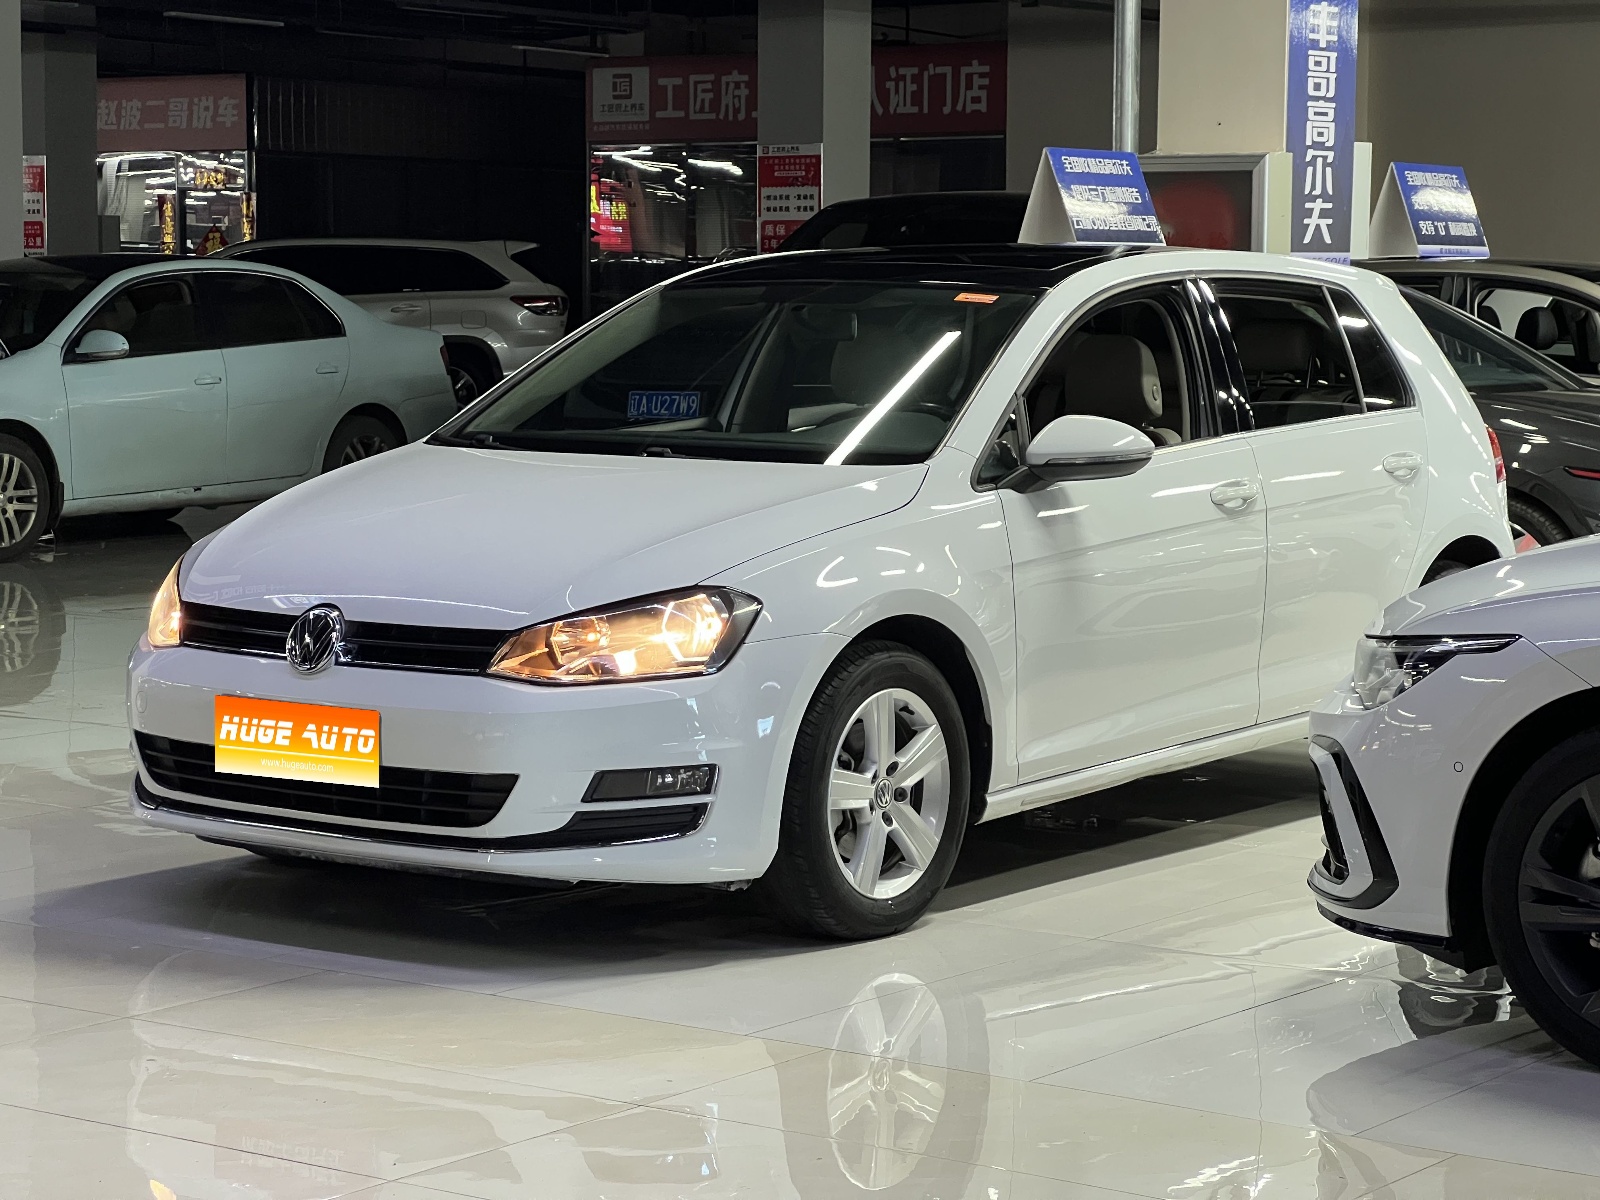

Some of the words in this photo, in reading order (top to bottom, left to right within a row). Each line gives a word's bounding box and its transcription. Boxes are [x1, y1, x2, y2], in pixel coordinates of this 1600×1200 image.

[655, 69, 757, 121] 工匠府
[97, 96, 239, 130] 赵波二哥说车
[764, 224, 786, 236] 质保
[763, 239, 784, 249] 3年
